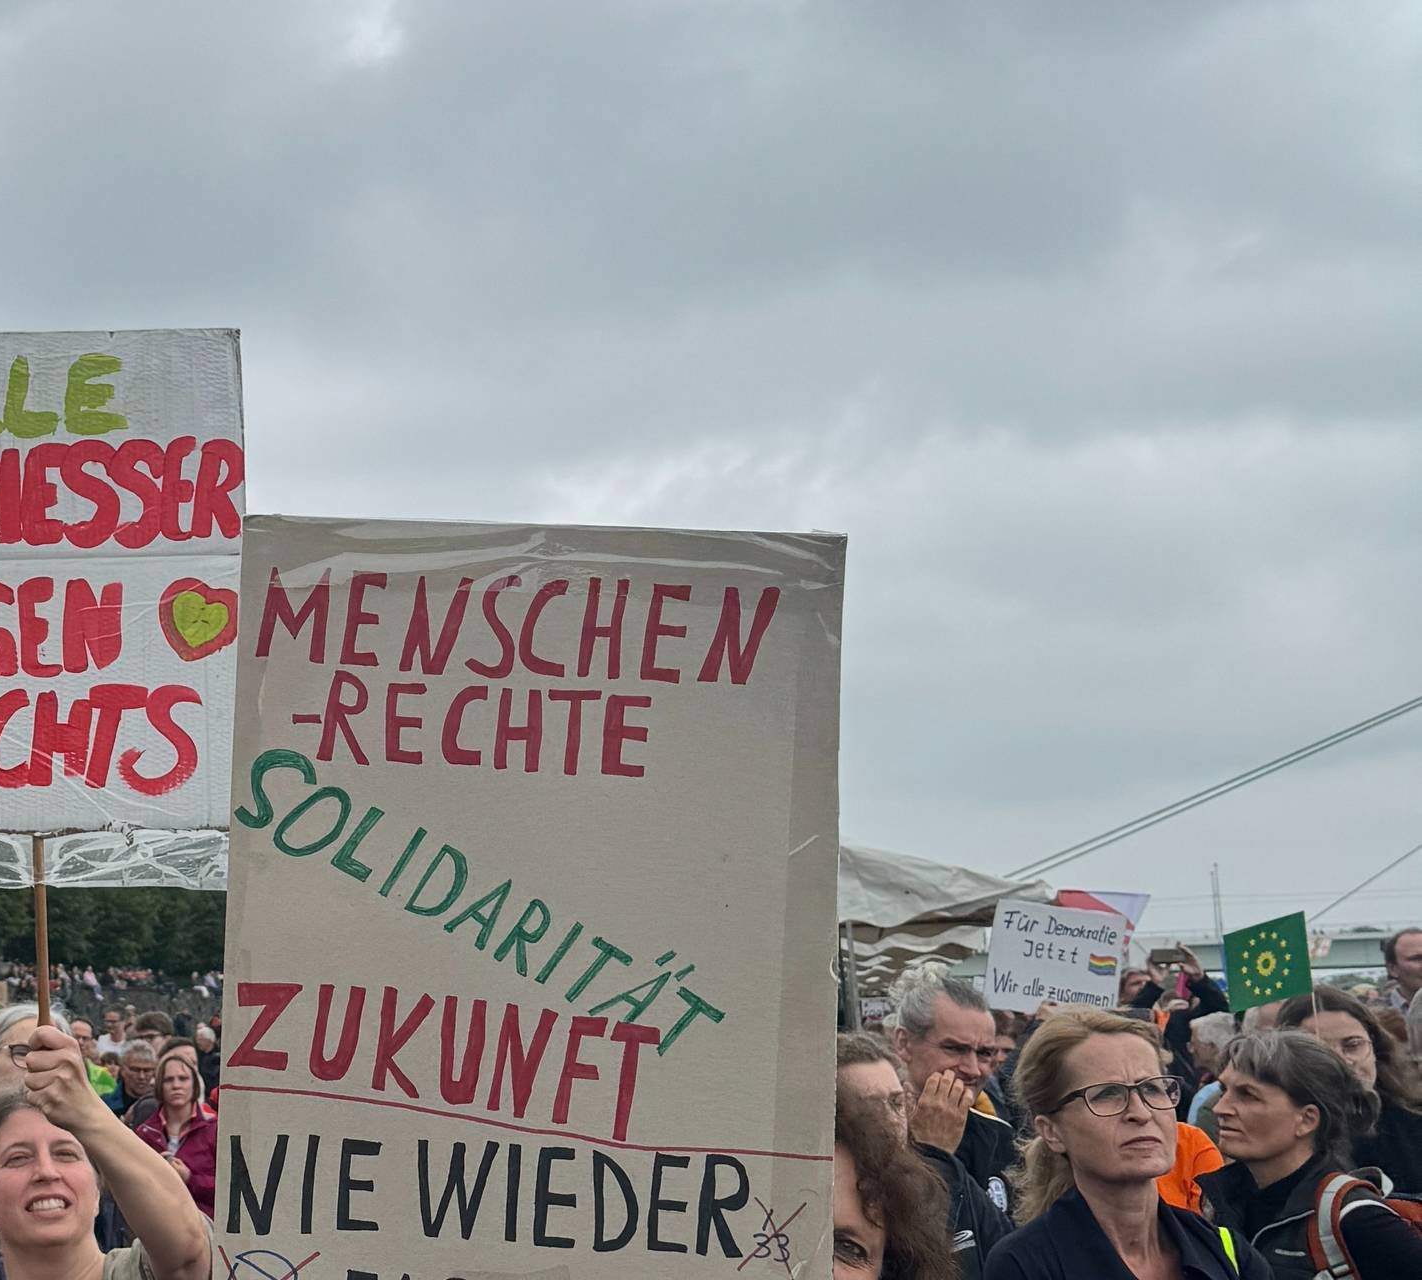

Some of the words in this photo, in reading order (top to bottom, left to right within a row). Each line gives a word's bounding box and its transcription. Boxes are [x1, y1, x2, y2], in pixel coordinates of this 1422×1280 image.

[255, 566, 782, 686] MENSCHEN
[291, 670, 653, 778] -RECHTE
[233, 748, 727, 1057] SOLIDARITÄT
[1003, 910, 1039, 933] Für
[1044, 915, 1118, 945] Demokratie
[993, 967, 1019, 994] Wir
[1022, 976, 1046, 998] alle
[1048, 985, 1115, 1008] zusammen!
[226, 982, 662, 1142] ZUKUNFT
[226, 1134, 382, 1235] NIE
[417, 1138, 751, 1259] WIEDER
